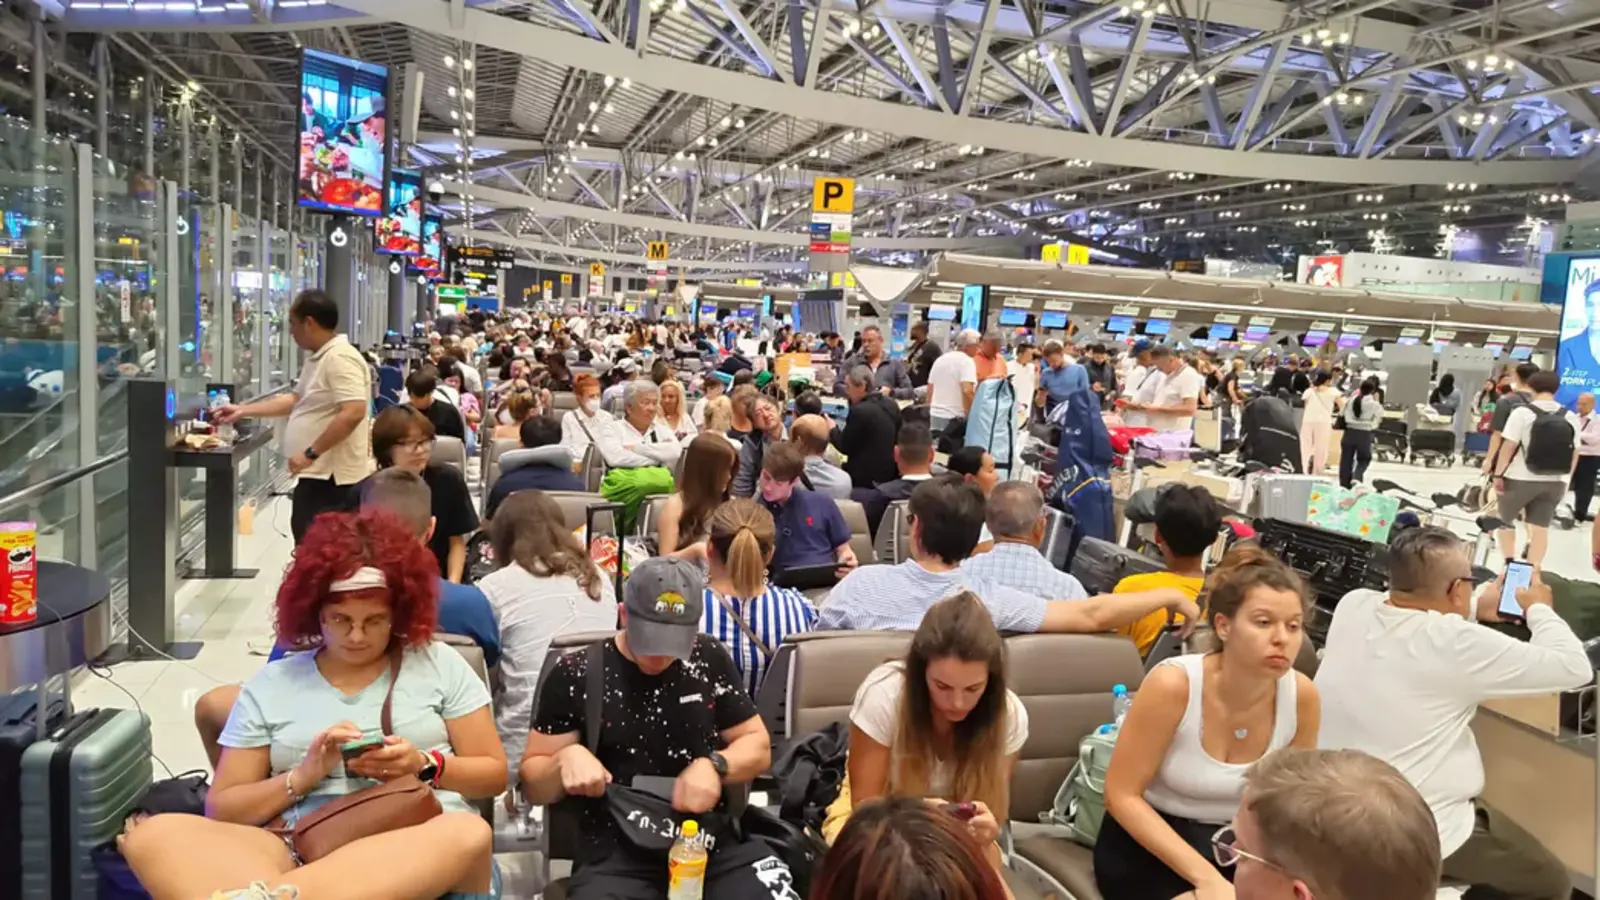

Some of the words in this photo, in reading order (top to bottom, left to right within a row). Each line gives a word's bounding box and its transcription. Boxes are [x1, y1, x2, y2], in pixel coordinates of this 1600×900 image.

[823, 182, 843, 208] P
[651, 243, 665, 258] M
[592, 264, 600, 275] K
